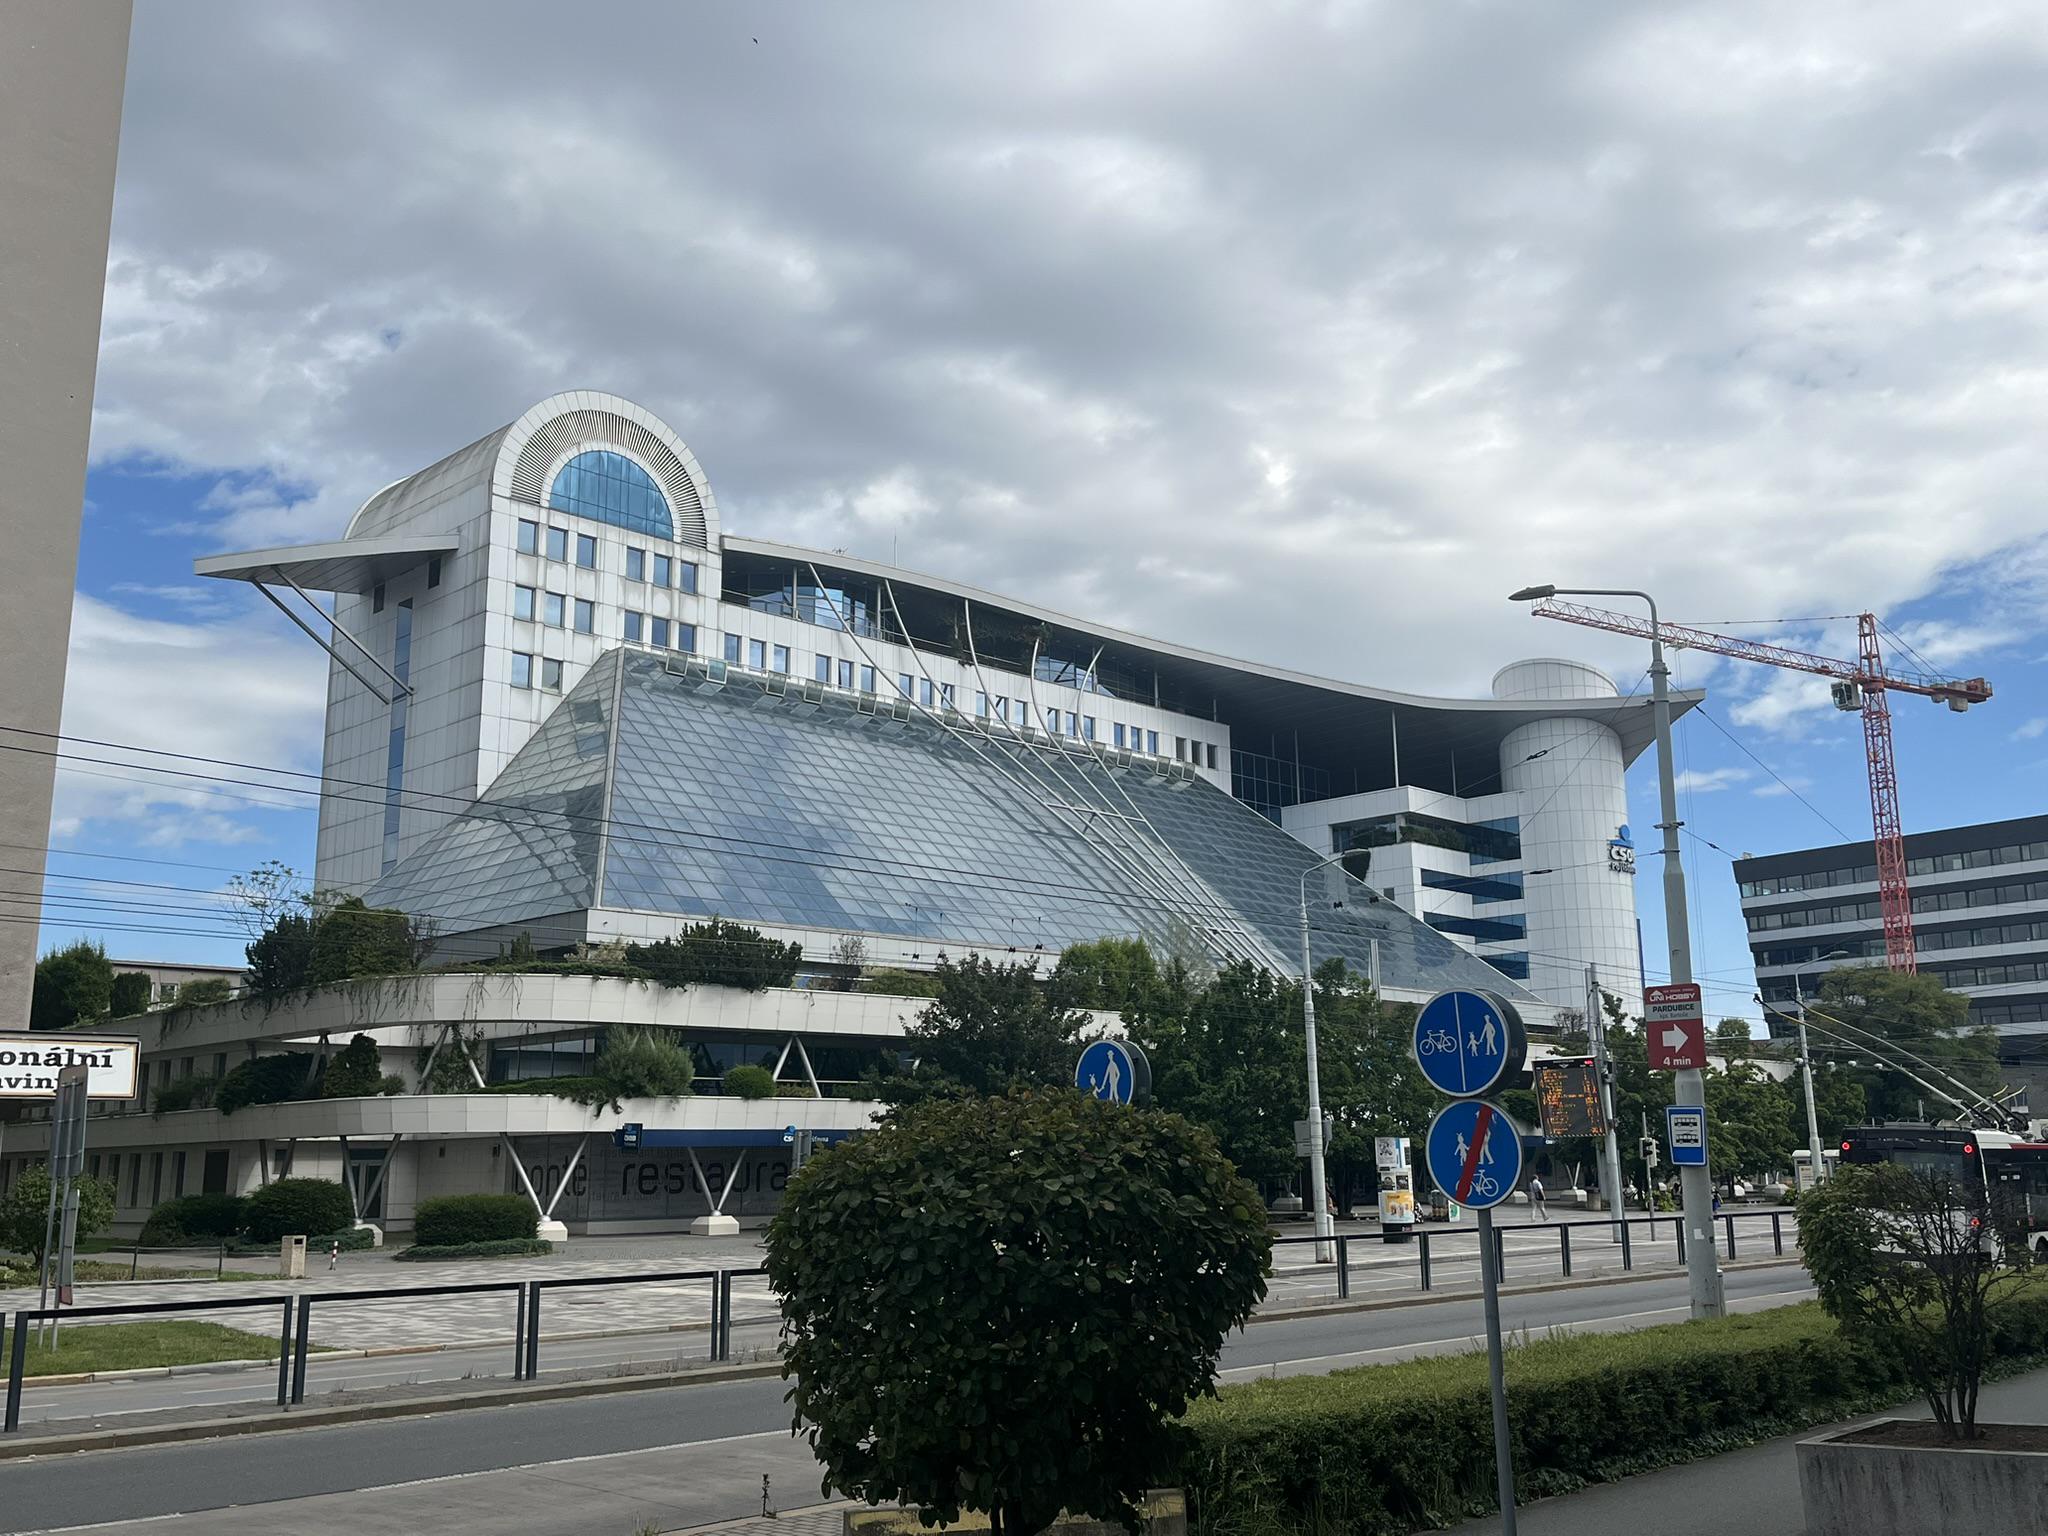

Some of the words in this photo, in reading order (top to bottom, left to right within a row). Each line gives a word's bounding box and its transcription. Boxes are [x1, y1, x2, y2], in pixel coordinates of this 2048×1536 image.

[1665, 993, 1695, 1001] HOBBY
[1652, 1003, 1694, 1013] PARDUBICE
[1663, 1056, 1671, 1066] 4
[1673, 1056, 1692, 1066] min
[0, 1073, 58, 1094] vin
